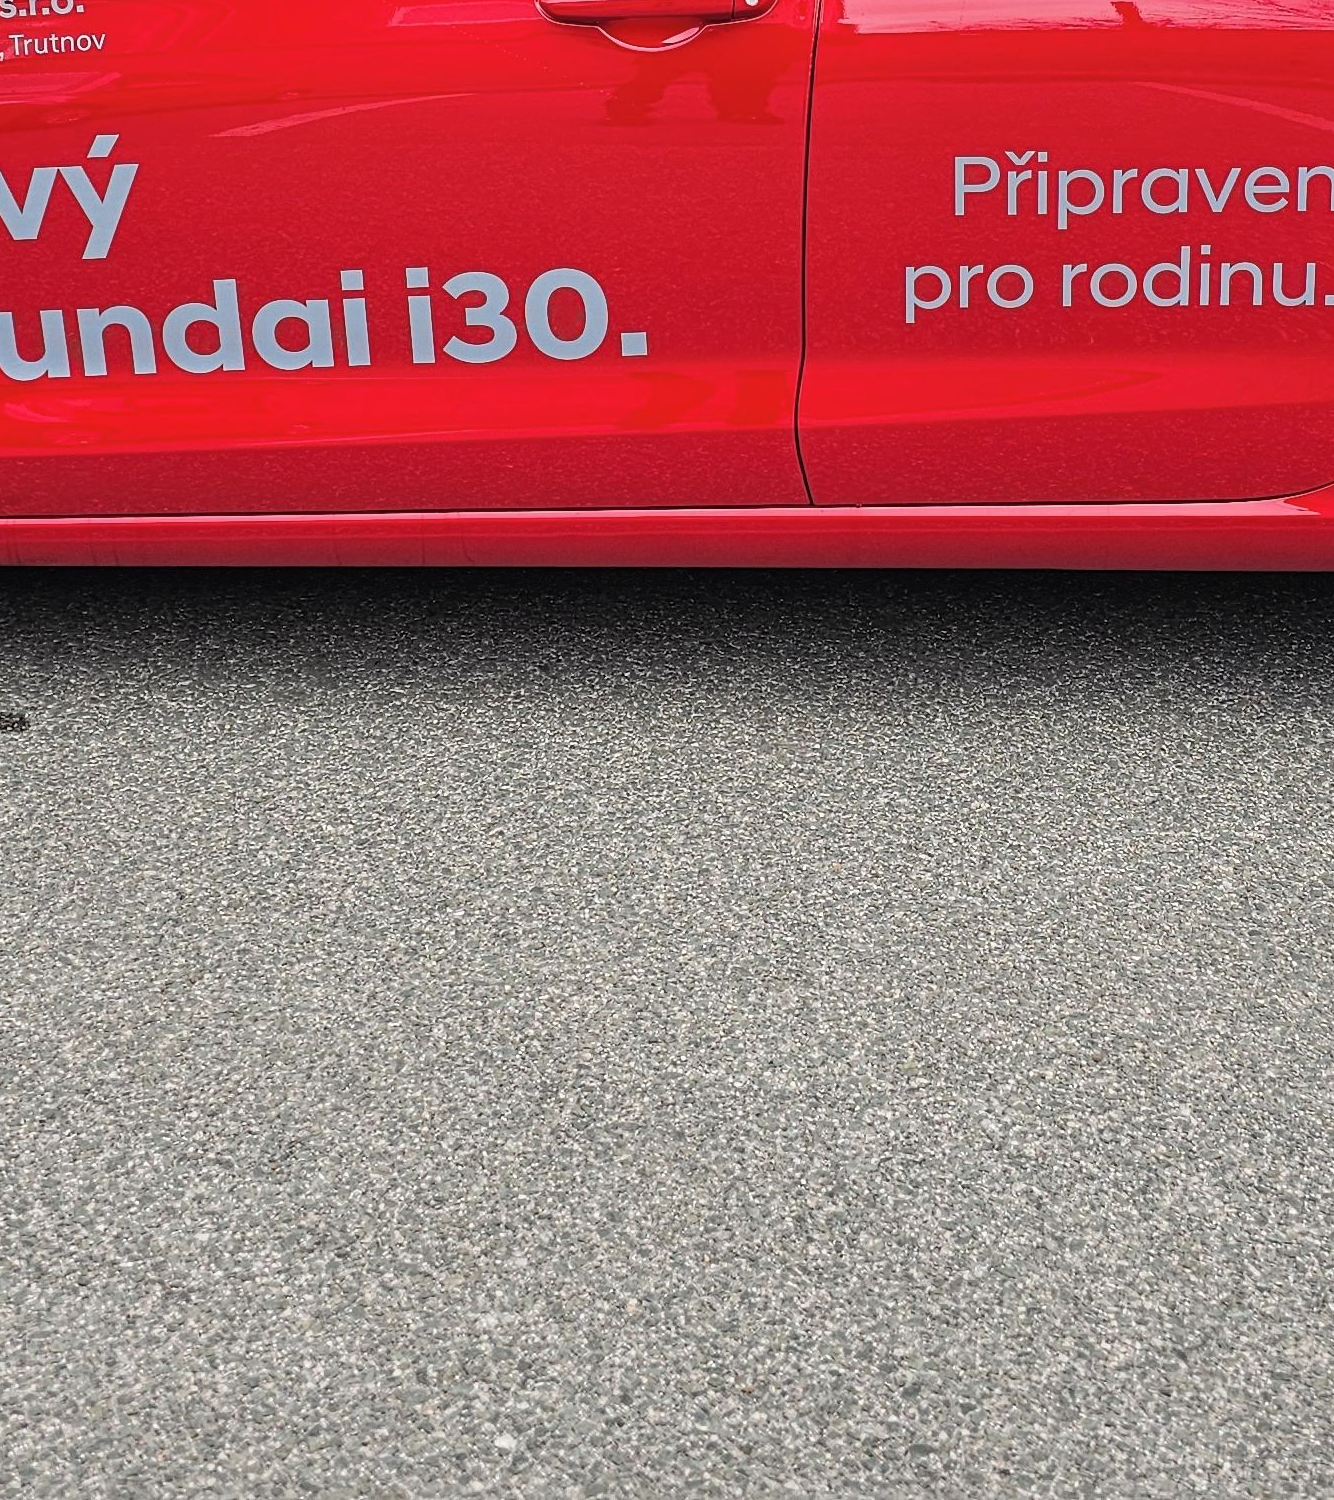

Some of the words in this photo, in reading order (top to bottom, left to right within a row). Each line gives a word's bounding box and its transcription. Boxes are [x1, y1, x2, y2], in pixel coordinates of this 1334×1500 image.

[9, 33, 106, 56] Trutnov
[405, 266, 649, 365] i30.
[905, 264, 1035, 323] pro
